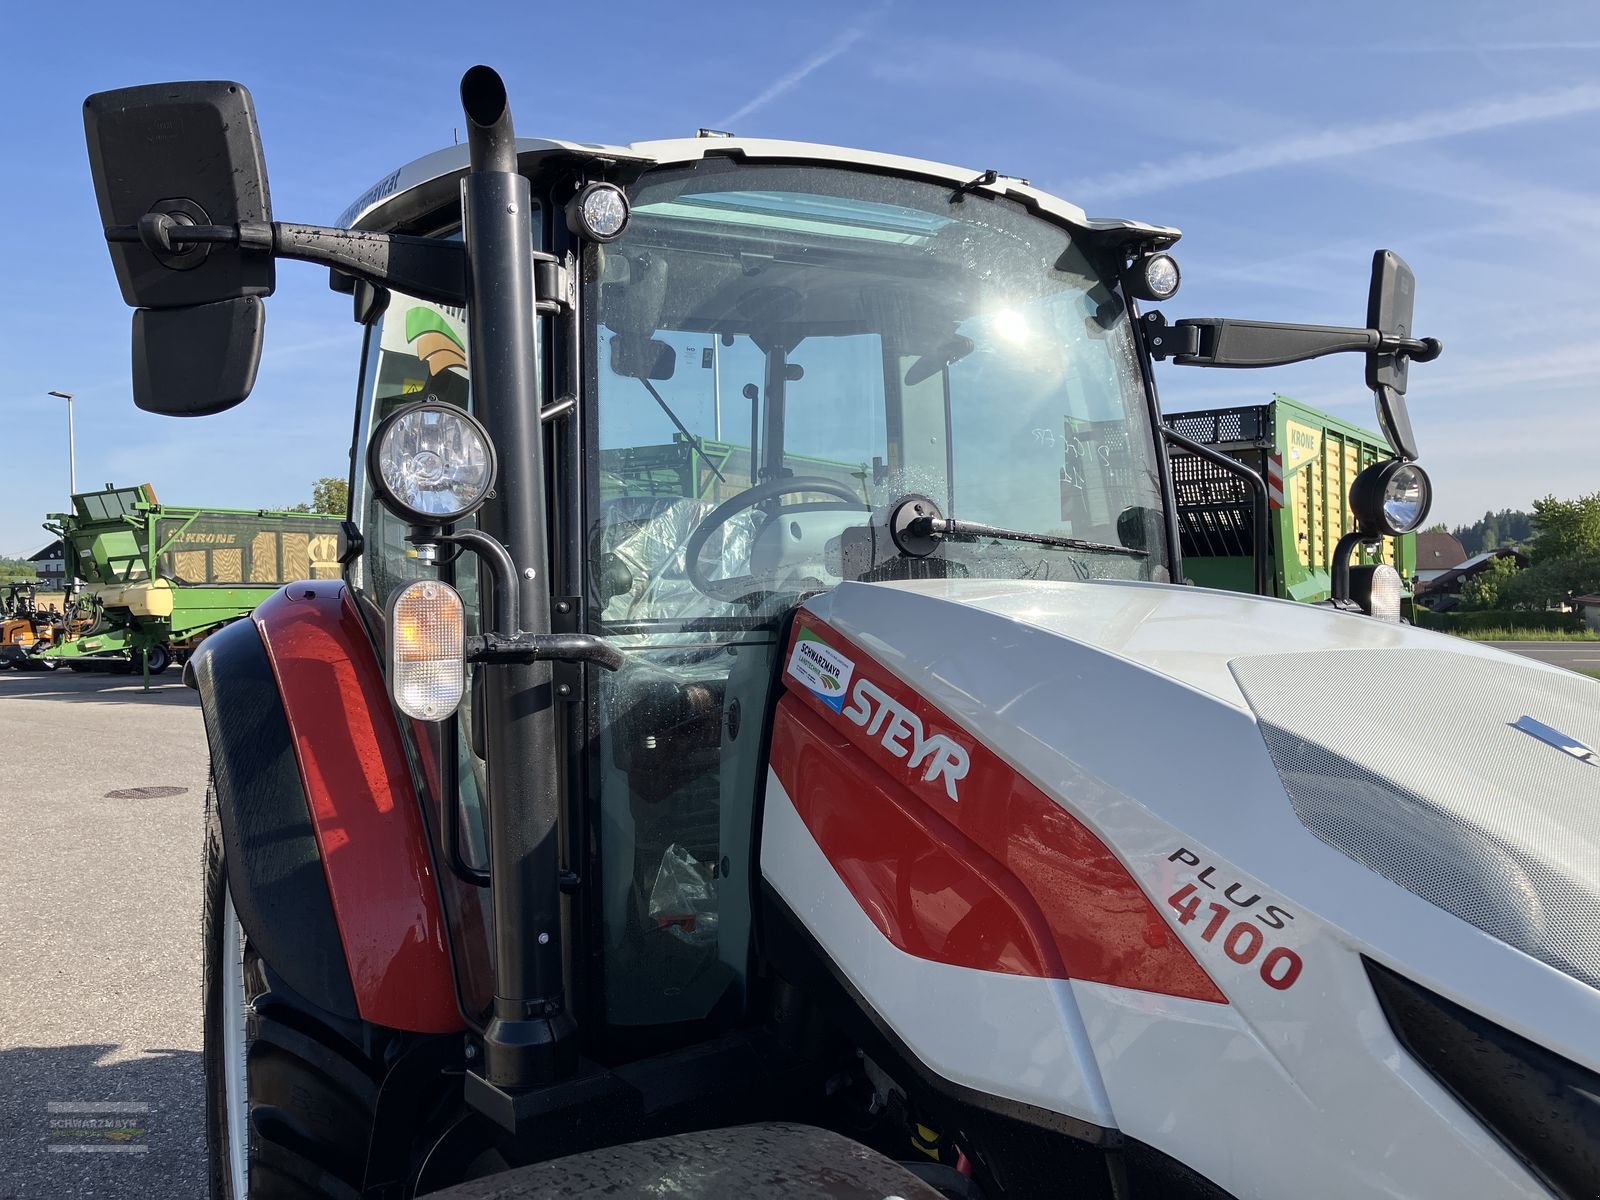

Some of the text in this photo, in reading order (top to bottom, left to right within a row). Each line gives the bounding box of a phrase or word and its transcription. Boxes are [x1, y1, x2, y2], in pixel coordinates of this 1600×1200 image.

[1291, 429, 1315, 450] KRONE
[185, 533, 237, 544] KRONE
[800, 643, 841, 679] SCHWARZMAYR
[842, 678, 970, 802] STEYR
[1167, 847, 1295, 929] PLUS
[1168, 883, 1303, 990] 4100
